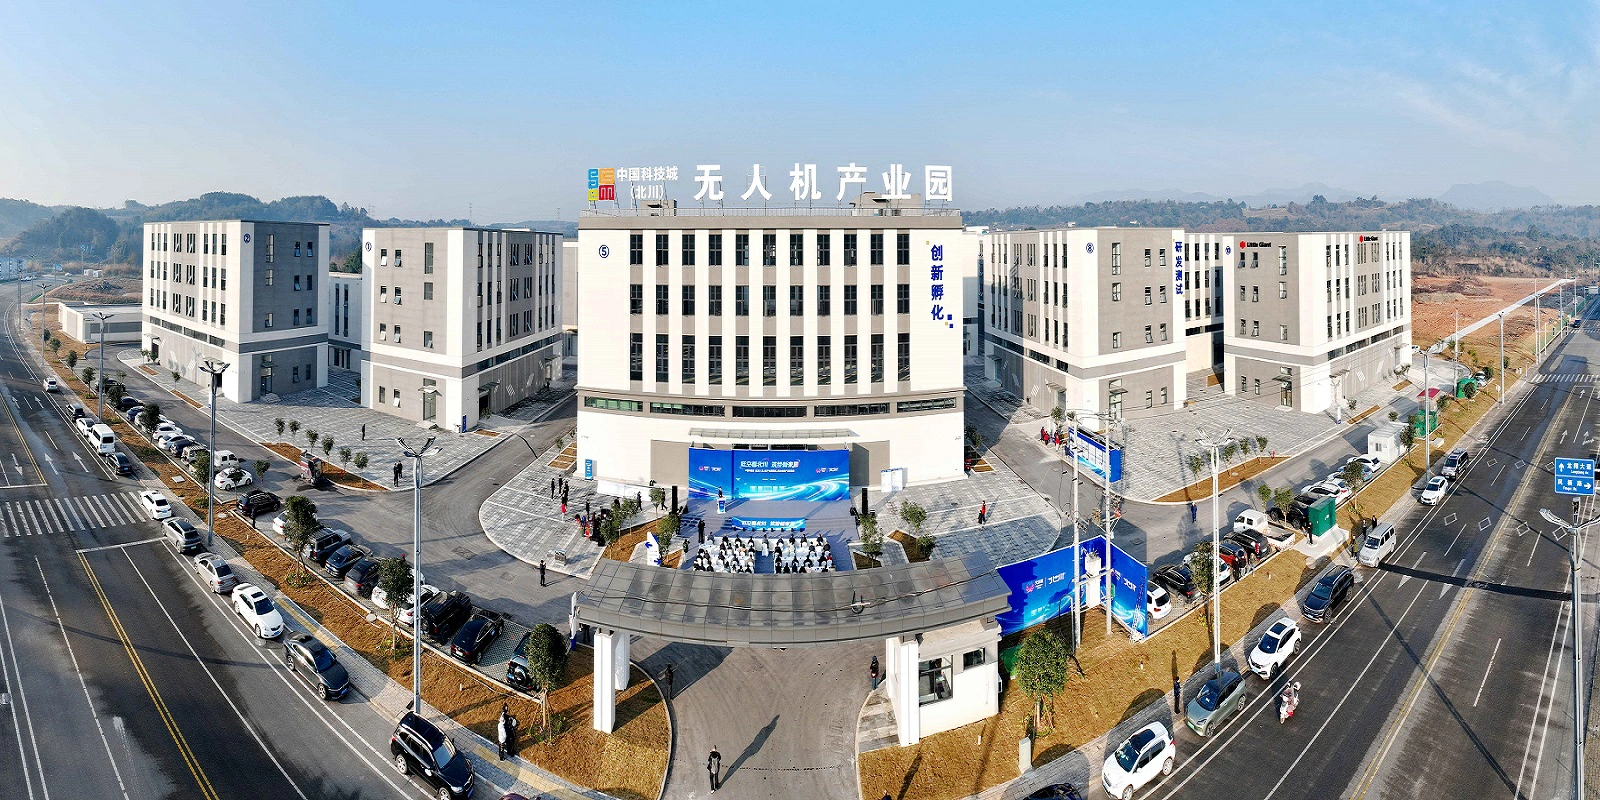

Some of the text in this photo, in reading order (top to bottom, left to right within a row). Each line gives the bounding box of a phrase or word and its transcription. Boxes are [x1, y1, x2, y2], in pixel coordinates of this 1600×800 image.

[616, 166, 679, 182] 中国科技城
[694, 163, 953, 201] 无人机产业园
[931, 245, 944, 320] 创新孵化
